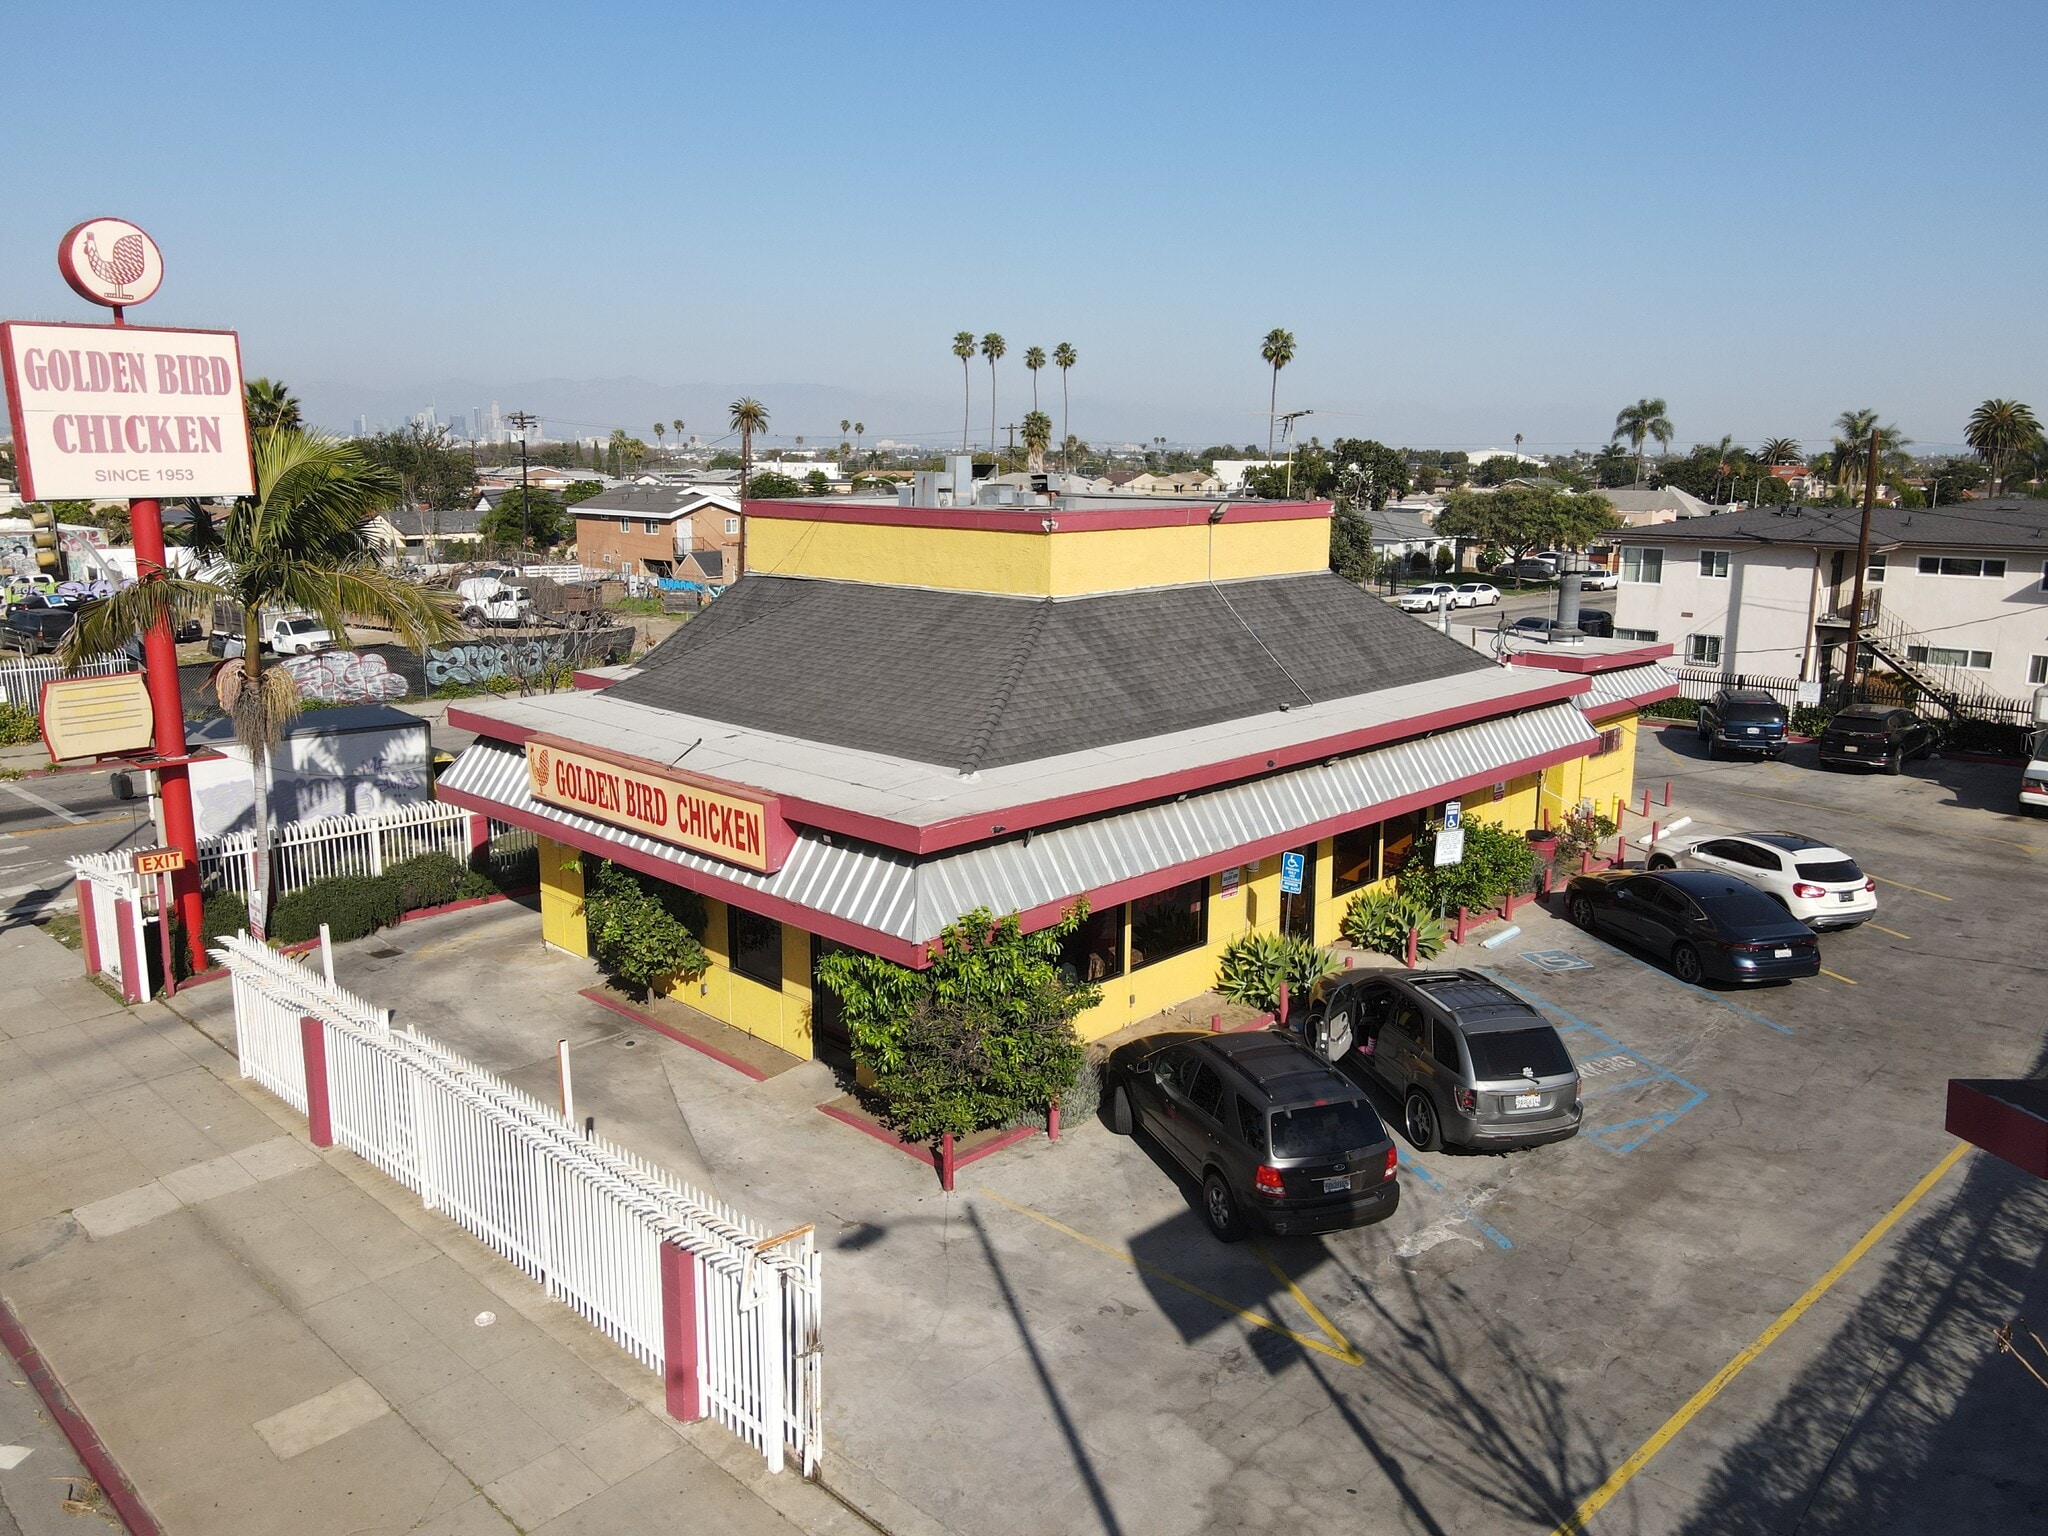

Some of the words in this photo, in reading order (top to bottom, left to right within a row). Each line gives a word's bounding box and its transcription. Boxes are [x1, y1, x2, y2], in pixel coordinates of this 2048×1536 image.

[24, 348, 147, 393] GOLDEN
[155, 354, 231, 396] BIRD
[53, 414, 222, 454] CHICKEN
[95, 469, 150, 482] SINCE
[156, 469, 194, 482] 1953
[556, 759, 620, 812] GOLDEN
[625, 779, 667, 826] BIRD
[677, 794, 759, 855] CHICKEN
[142, 853, 180, 872] EXIT
